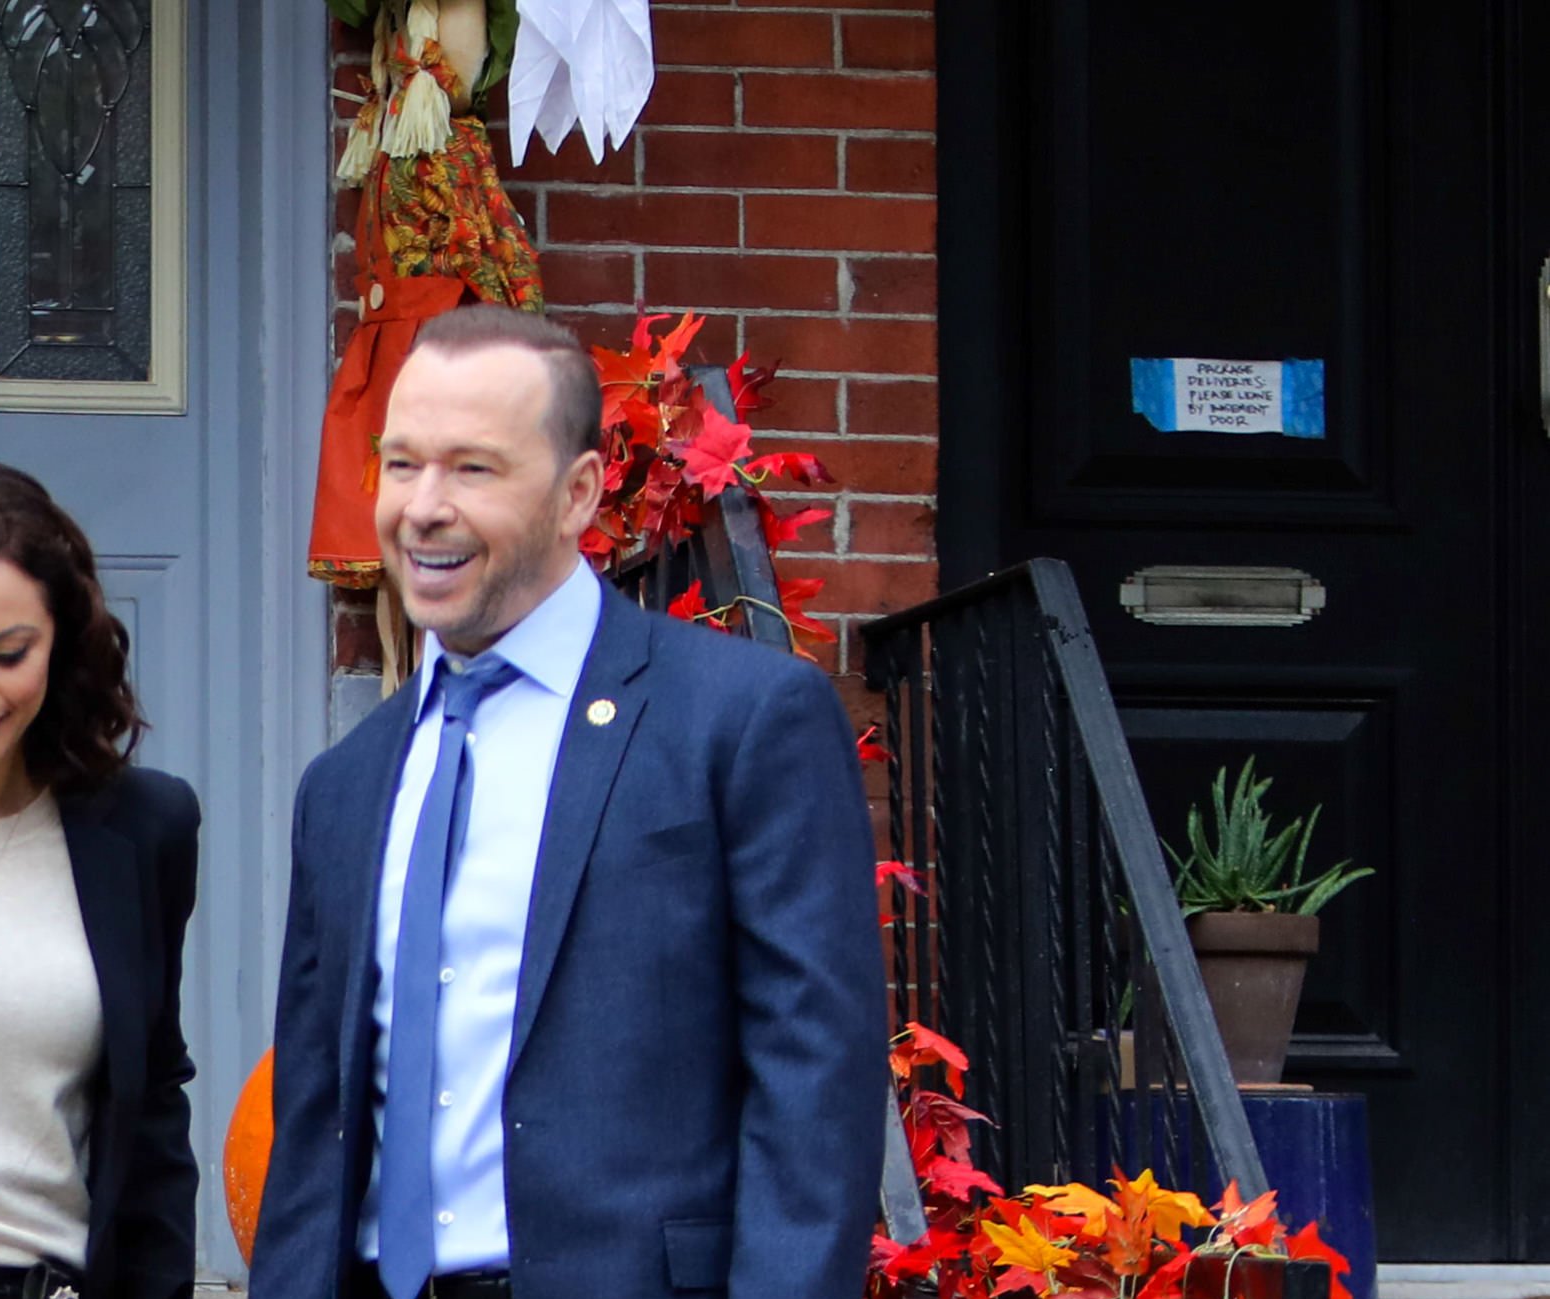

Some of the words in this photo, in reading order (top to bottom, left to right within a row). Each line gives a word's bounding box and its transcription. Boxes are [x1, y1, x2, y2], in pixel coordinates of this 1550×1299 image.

[1197, 363, 1254, 375] PACKAGE
[1189, 390, 1233, 402] PLEASE
[1238, 391, 1273, 401] LEAVE
[1188, 404, 1204, 415] BY
[1209, 415, 1249, 426] DOOR
